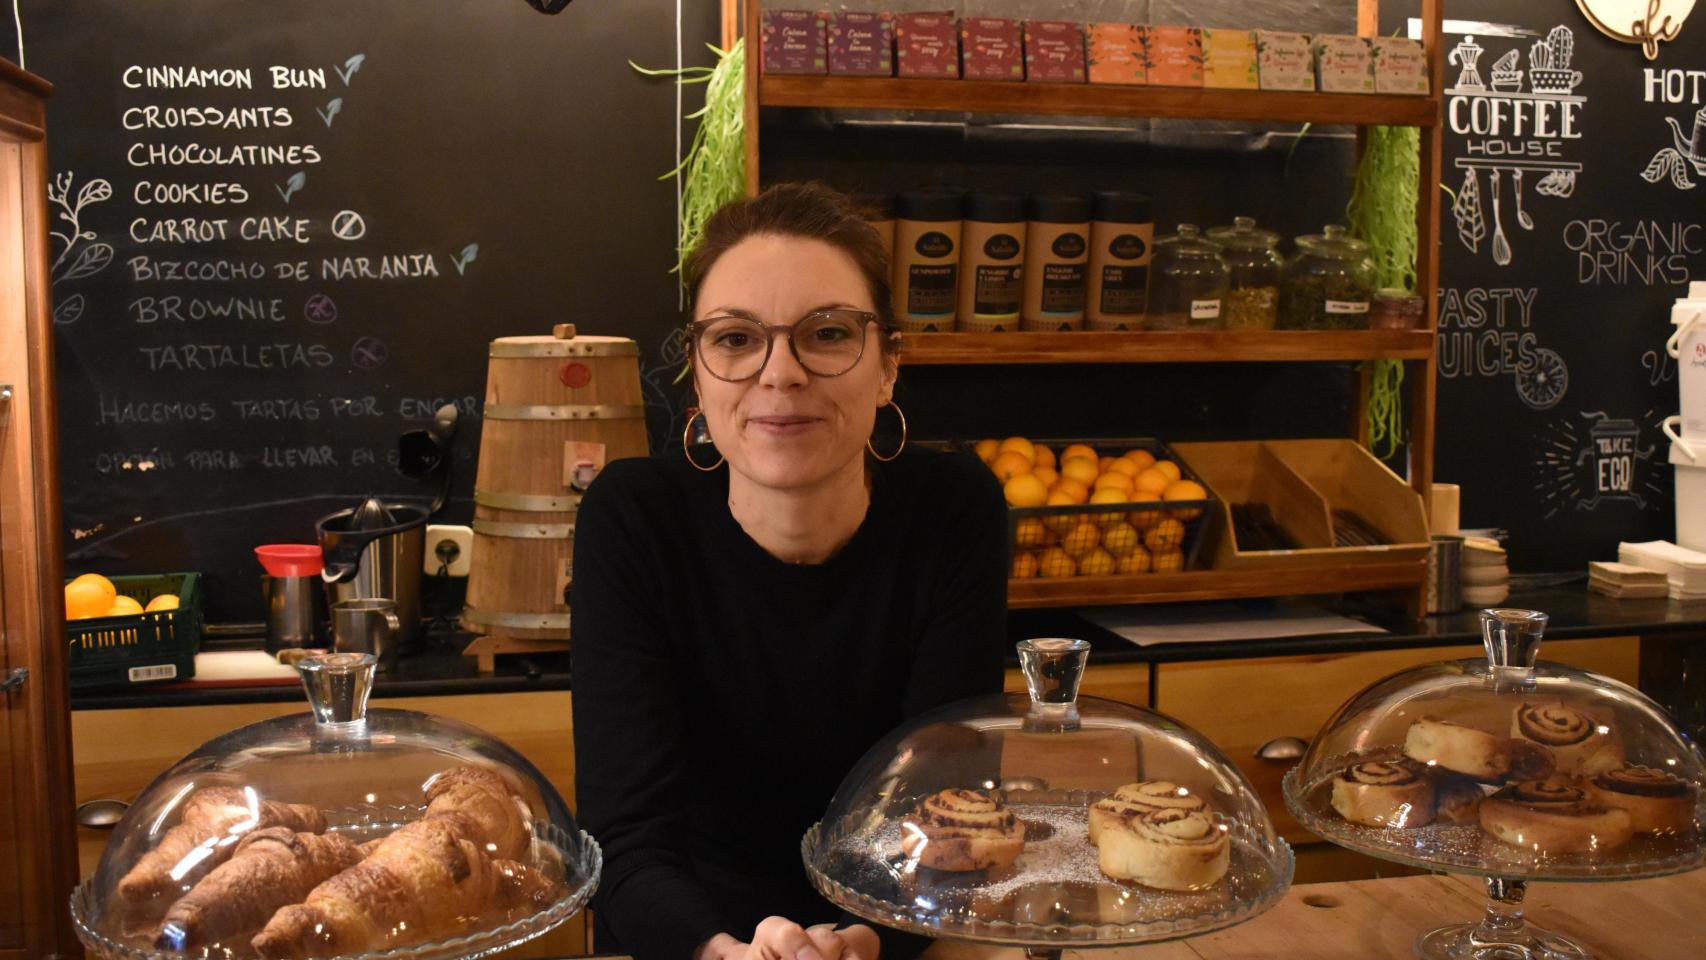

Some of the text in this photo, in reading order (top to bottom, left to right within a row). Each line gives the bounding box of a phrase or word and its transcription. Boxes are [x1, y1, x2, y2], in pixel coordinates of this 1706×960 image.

[123, 65, 327, 89] CINNAMON BUN
[1643, 68, 1706, 104] HOT
[122, 106, 293, 129] CROISSANTS
[1448, 96, 1584, 138] COFFEE
[127, 143, 321, 166] CHOCOLATINES
[1467, 140, 1563, 157] HOUSE
[134, 181, 249, 205] COOKIES
[130, 217, 310, 243] CARROT CAKE
[1563, 219, 1703, 254] ORGANIC
[128, 254, 439, 281] BIZCOCHO DE NARANJA
[1579, 251, 1690, 285] DRINKS
[130, 296, 286, 323] BROWNIE
[140, 343, 334, 370] TARTALETAS
[1438, 329, 1538, 378] UICES
[97, 396, 216, 424] HACEMOS
[232, 397, 319, 420] TARTAS
[330, 396, 383, 417] POR
[185, 449, 243, 471] PARA
[261, 445, 338, 467] LLEVAR
[1596, 437, 1633, 454] TAKE
[1597, 456, 1631, 491] ECO
